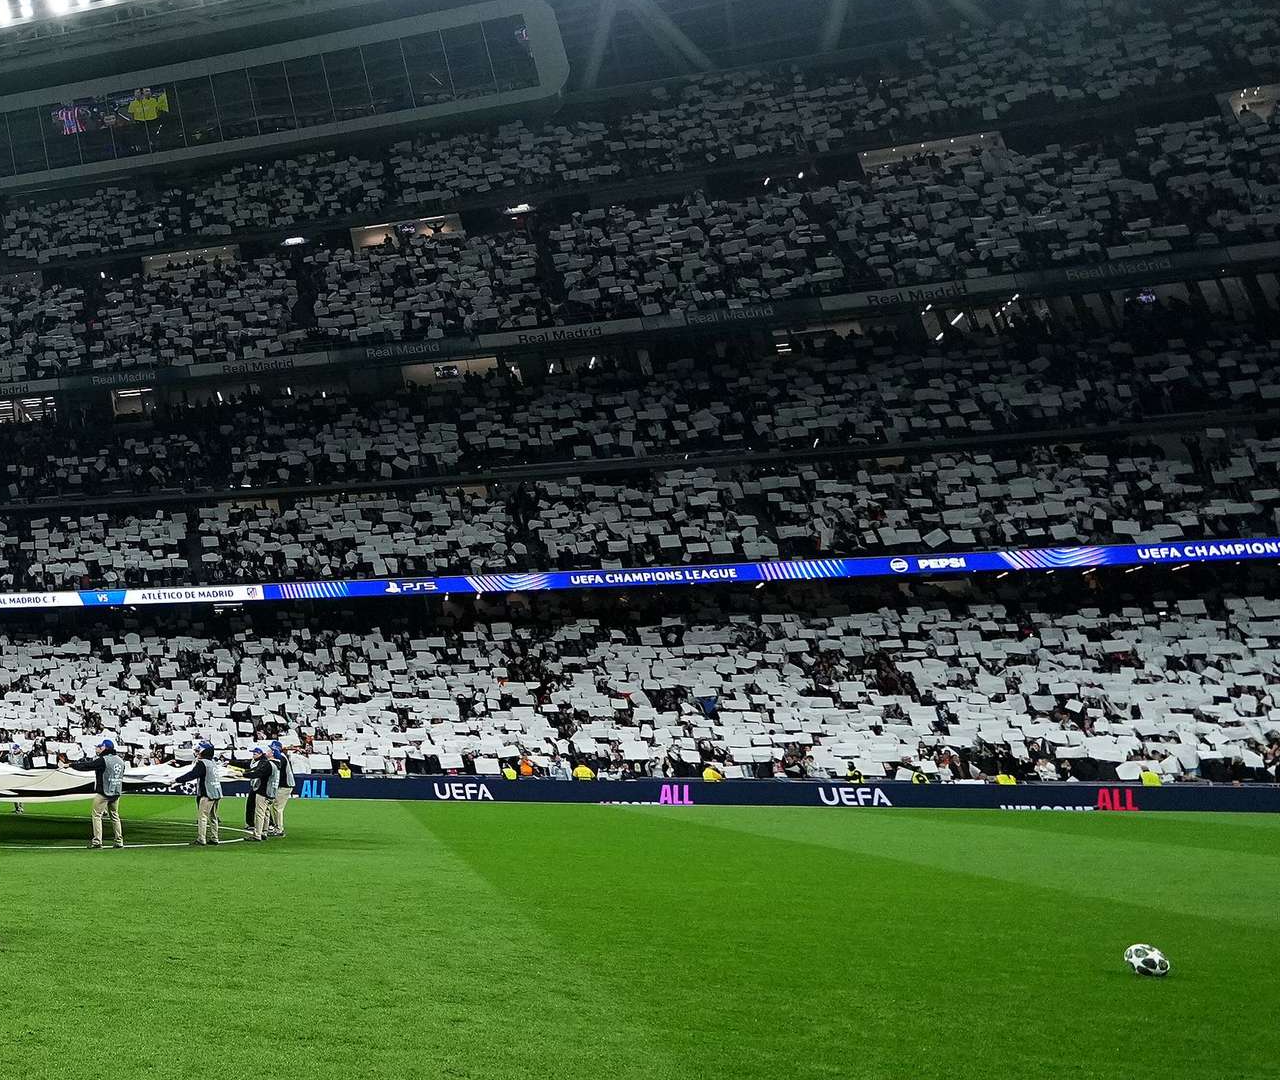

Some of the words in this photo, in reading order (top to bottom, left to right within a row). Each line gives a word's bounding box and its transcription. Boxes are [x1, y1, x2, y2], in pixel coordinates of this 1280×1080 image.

[867, 293, 905, 306] Real
[909, 284, 968, 303] Madrid
[518, 333, 550, 345] Real
[553, 327, 602, 341] Madrid
[222, 364, 249, 374] Real
[253, 358, 295, 372] Madrid
[1137, 547, 1182, 559] UEFA
[918, 557, 967, 569] PEPSI
[570, 574, 602, 586] UEFA
[605, 571, 683, 584] CHAMPIONS
[686, 568, 737, 581] LEAGUE
[401, 581, 438, 591] PS5
[9, 596, 41, 605] MADRID
[141, 590, 183, 601] ATLÉTICO
[184, 592, 197, 600] DE
[198, 590, 234, 599] MADRID
[301, 780, 329, 798] ALL
[434, 783, 494, 800] UEFA
[660, 784, 694, 805] ALL
[818, 787, 893, 806] UEFA
[1097, 788, 1138, 811] ALL
